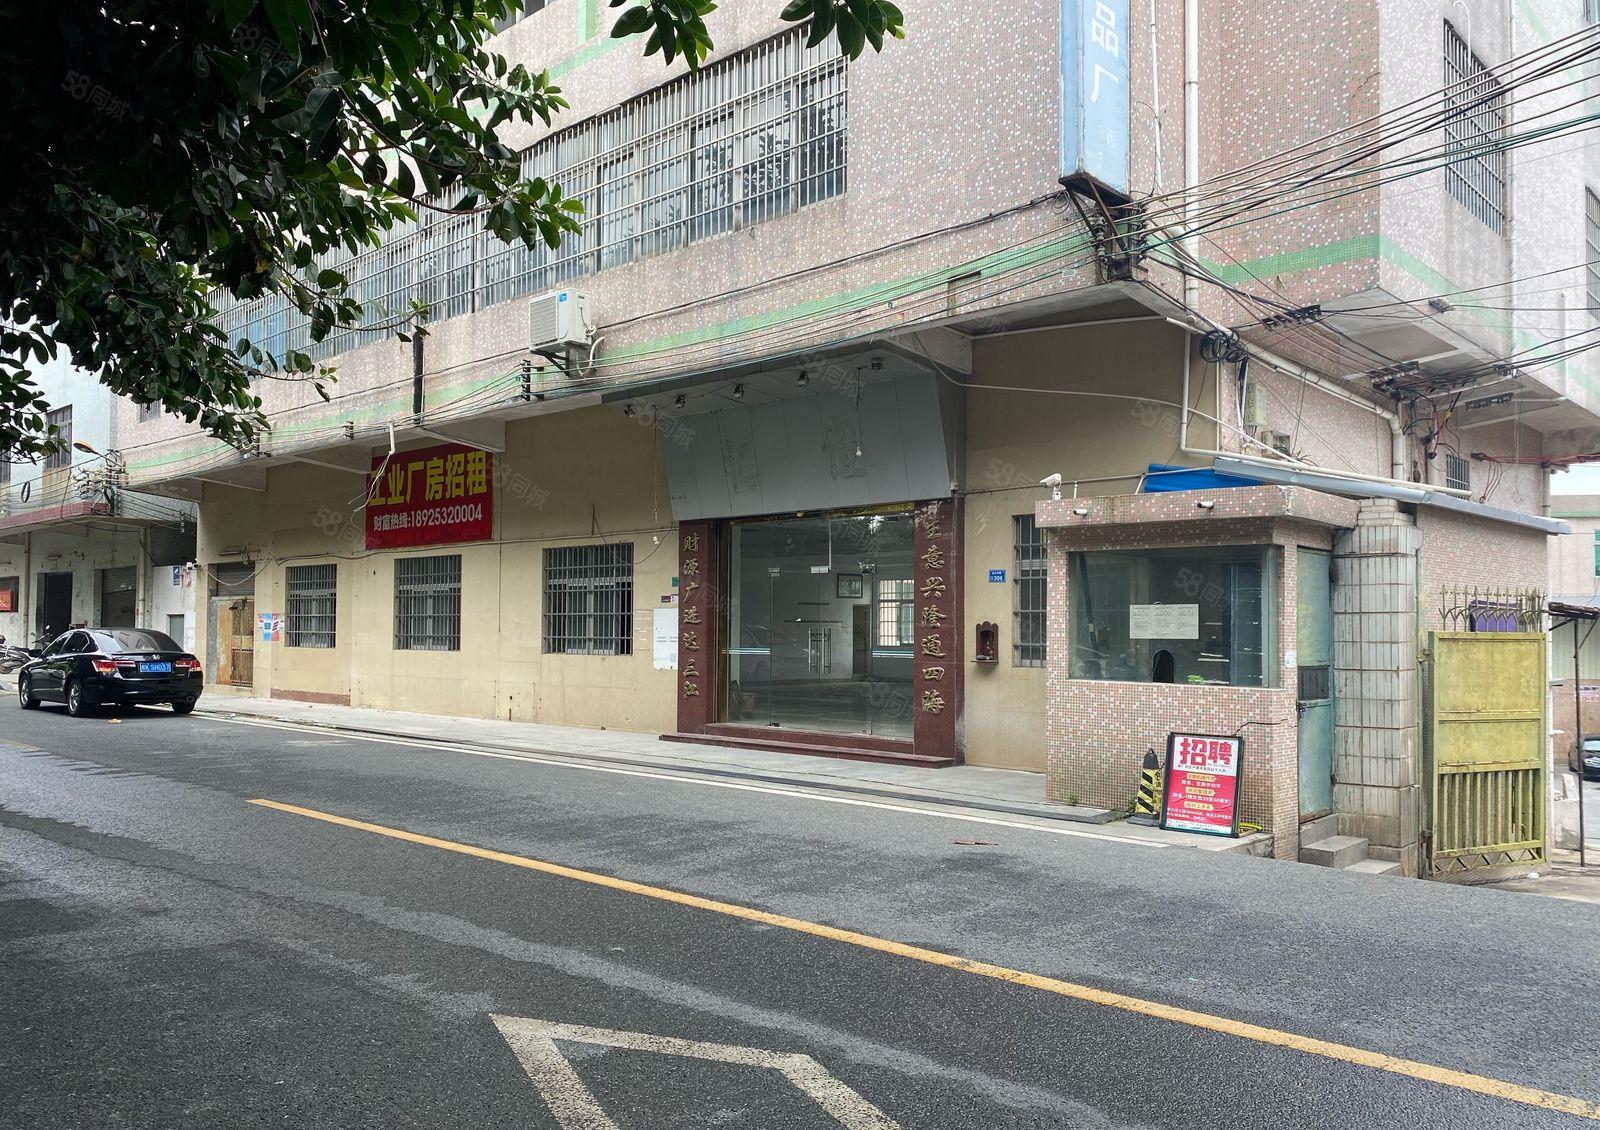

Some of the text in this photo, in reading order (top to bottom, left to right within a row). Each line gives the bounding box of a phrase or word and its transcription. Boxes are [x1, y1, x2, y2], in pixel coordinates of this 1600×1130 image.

[368, 451, 488, 507] 工业厂房招租
[373, 503, 482, 532] 财富热线:18925320004
[1180, 738, 1233, 766] 招聘
